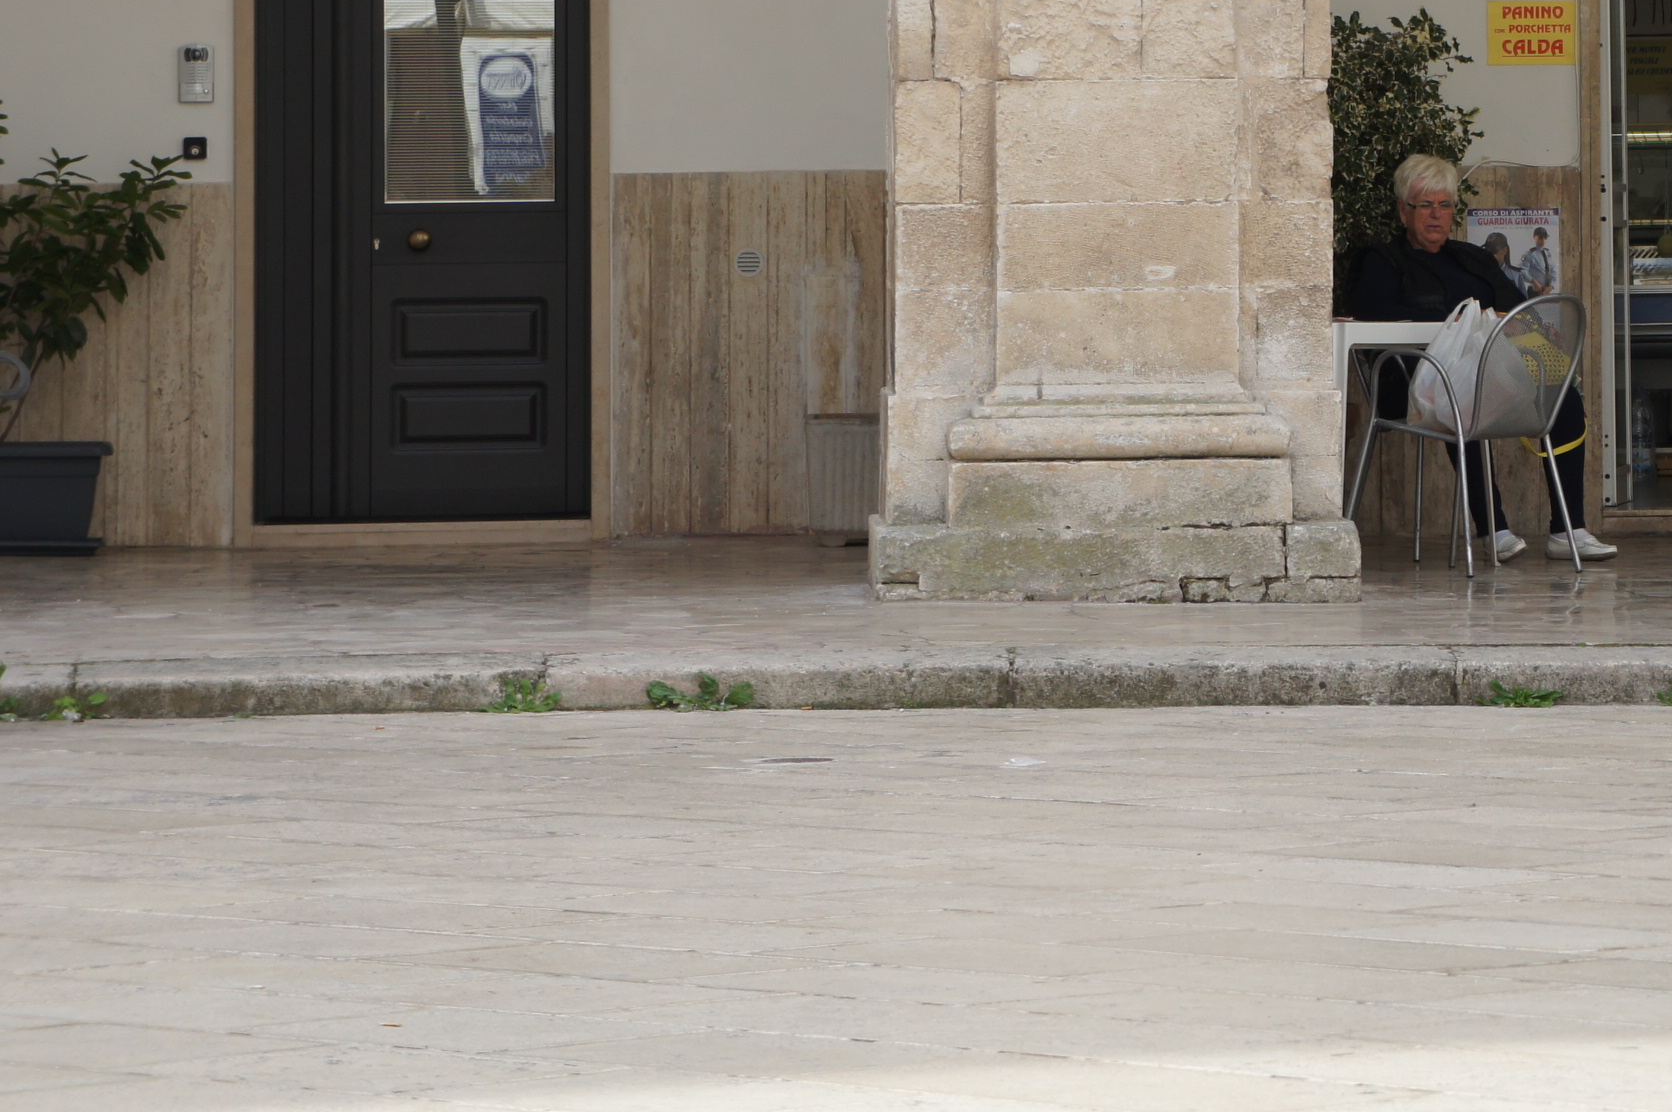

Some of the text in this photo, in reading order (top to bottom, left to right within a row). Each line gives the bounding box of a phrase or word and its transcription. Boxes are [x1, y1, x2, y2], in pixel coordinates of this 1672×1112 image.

[1502, 6, 1564, 20] PANINO
[1509, 25, 1571, 33] PORCHETTA
[1502, 39, 1564, 56] CALDA
[1515, 217, 1549, 225] GIURATA
